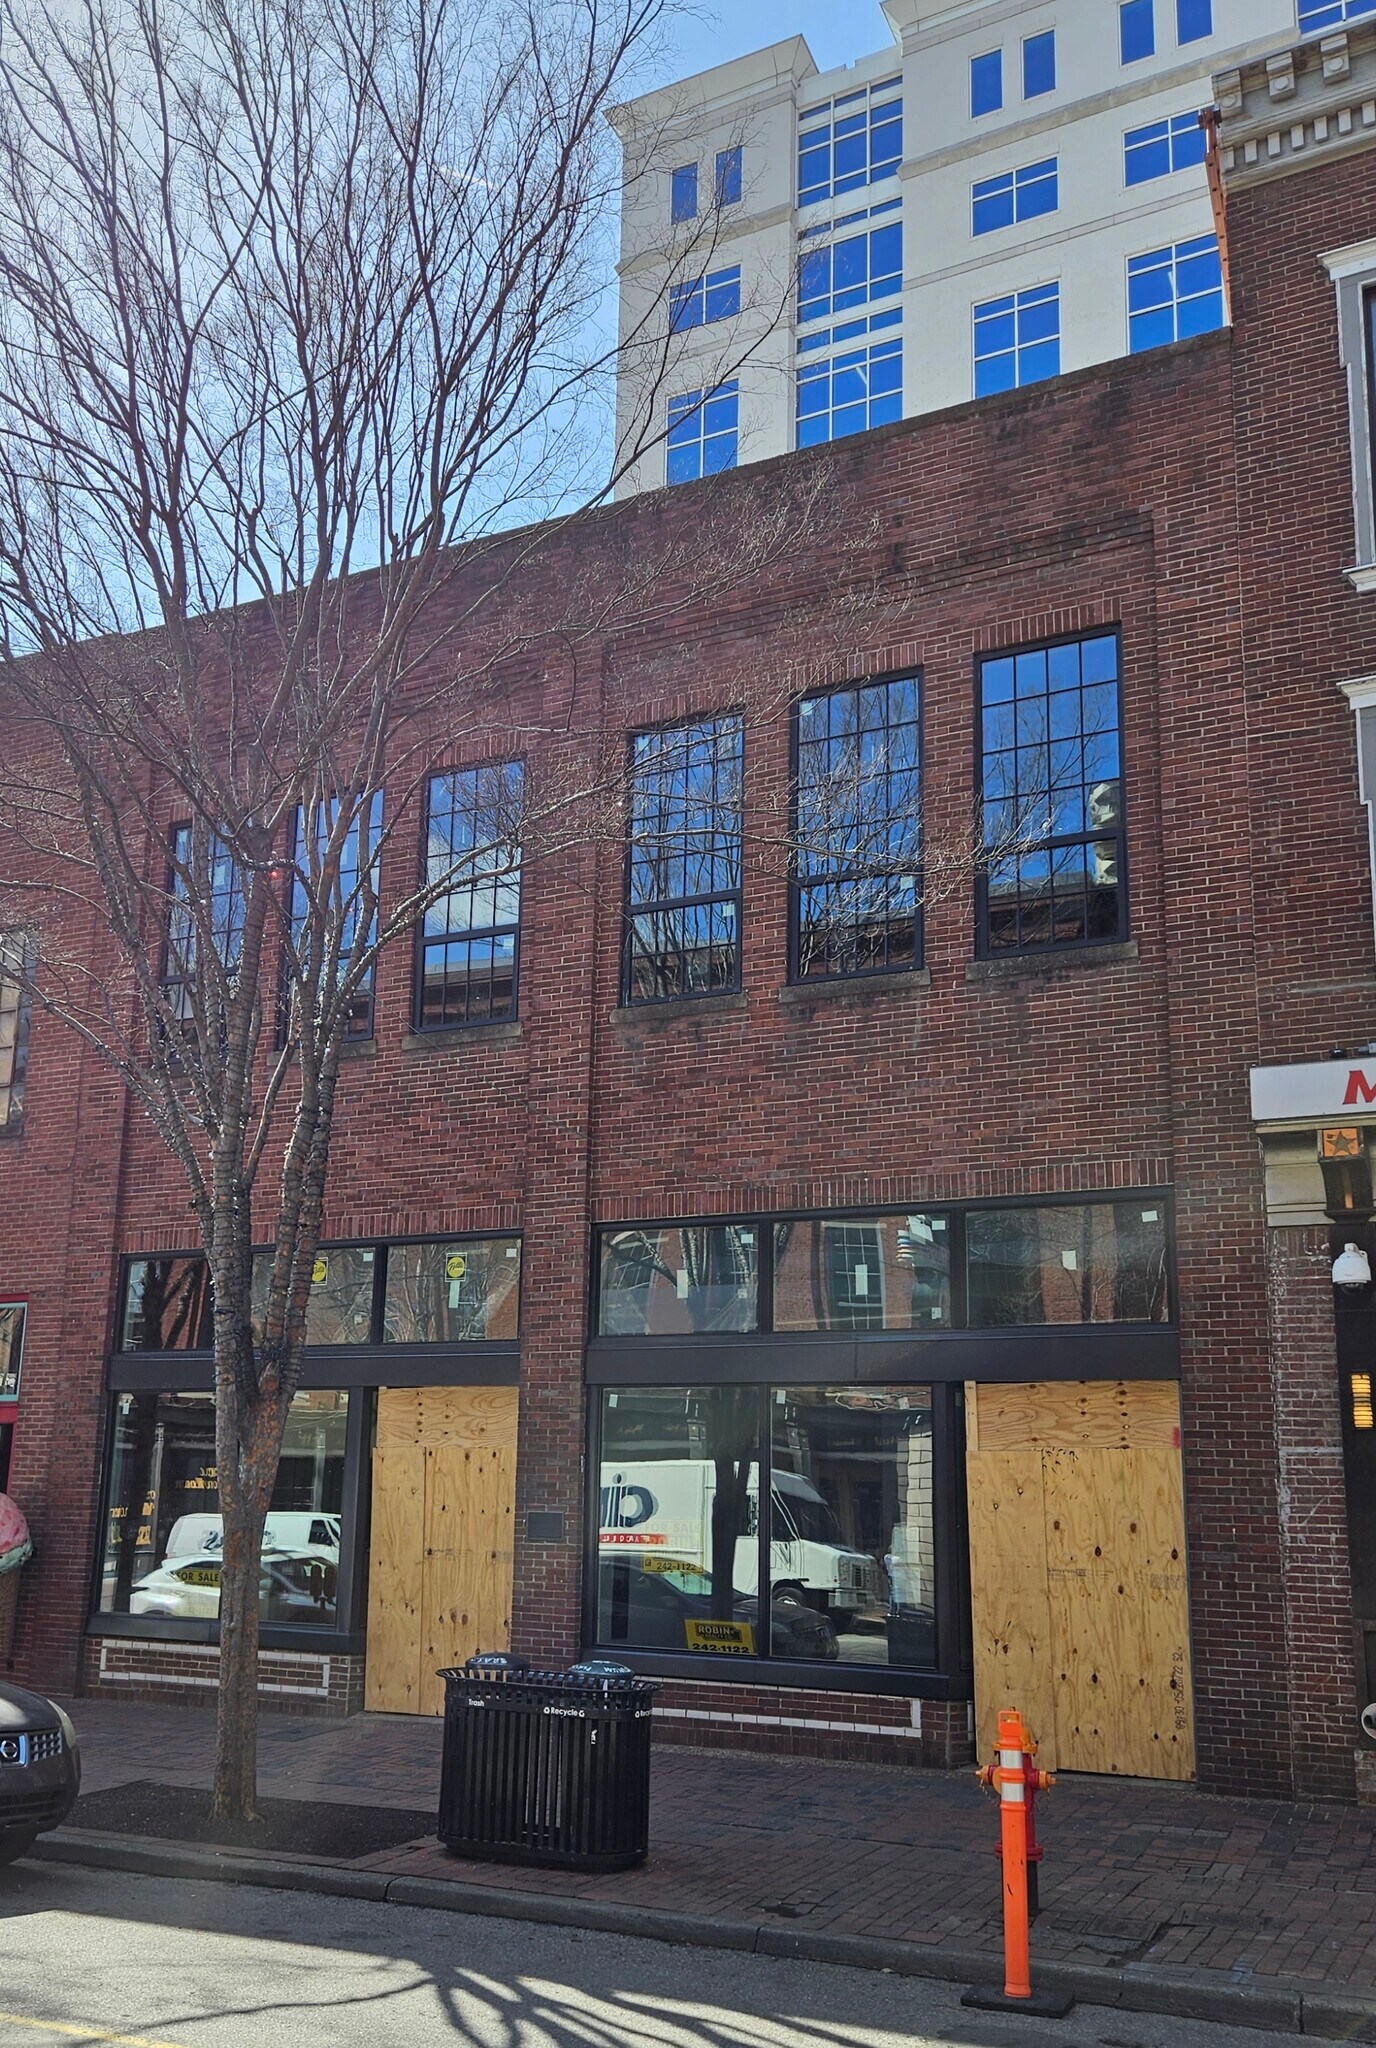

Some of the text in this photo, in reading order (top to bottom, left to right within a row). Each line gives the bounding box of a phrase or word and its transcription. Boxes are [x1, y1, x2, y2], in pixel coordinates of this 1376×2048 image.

[198, 1572, 219, 1582] SALE
[698, 1625, 730, 1635] ROBIN
[468, 1698, 485, 1707] Trash
[550, 1706, 578, 1718] Recycle
